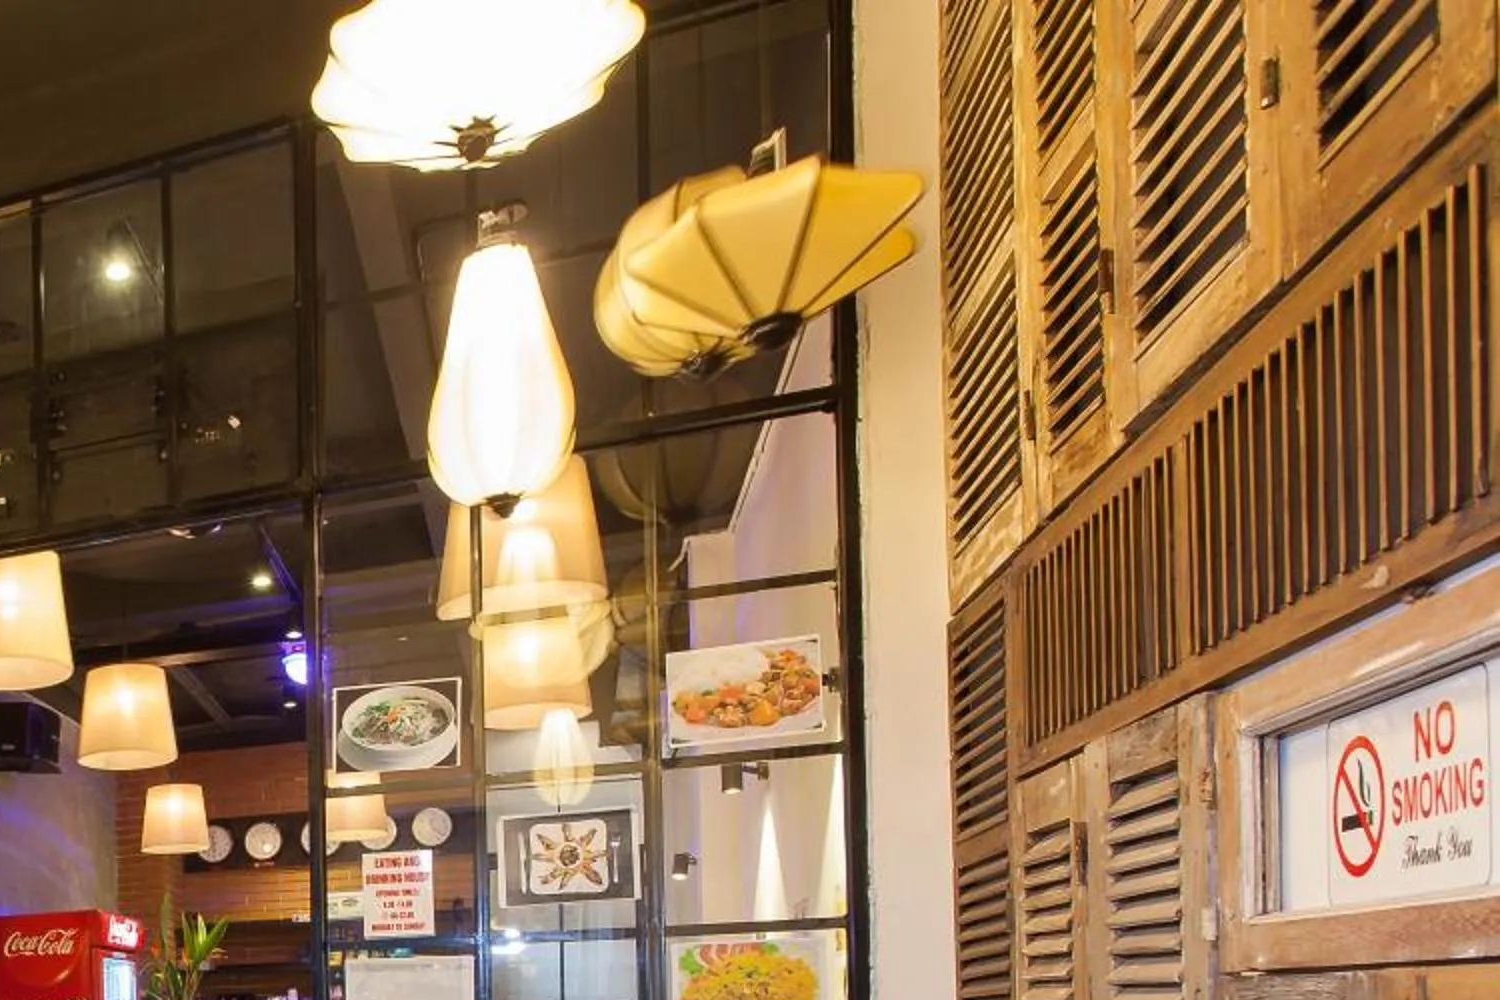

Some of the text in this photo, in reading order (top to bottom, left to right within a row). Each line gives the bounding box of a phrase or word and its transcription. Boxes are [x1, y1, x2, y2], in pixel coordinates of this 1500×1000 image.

[1413, 701, 1456, 762] NO
[1391, 757, 1485, 827] SMOKING
[1401, 825, 1474, 869] Thank You
